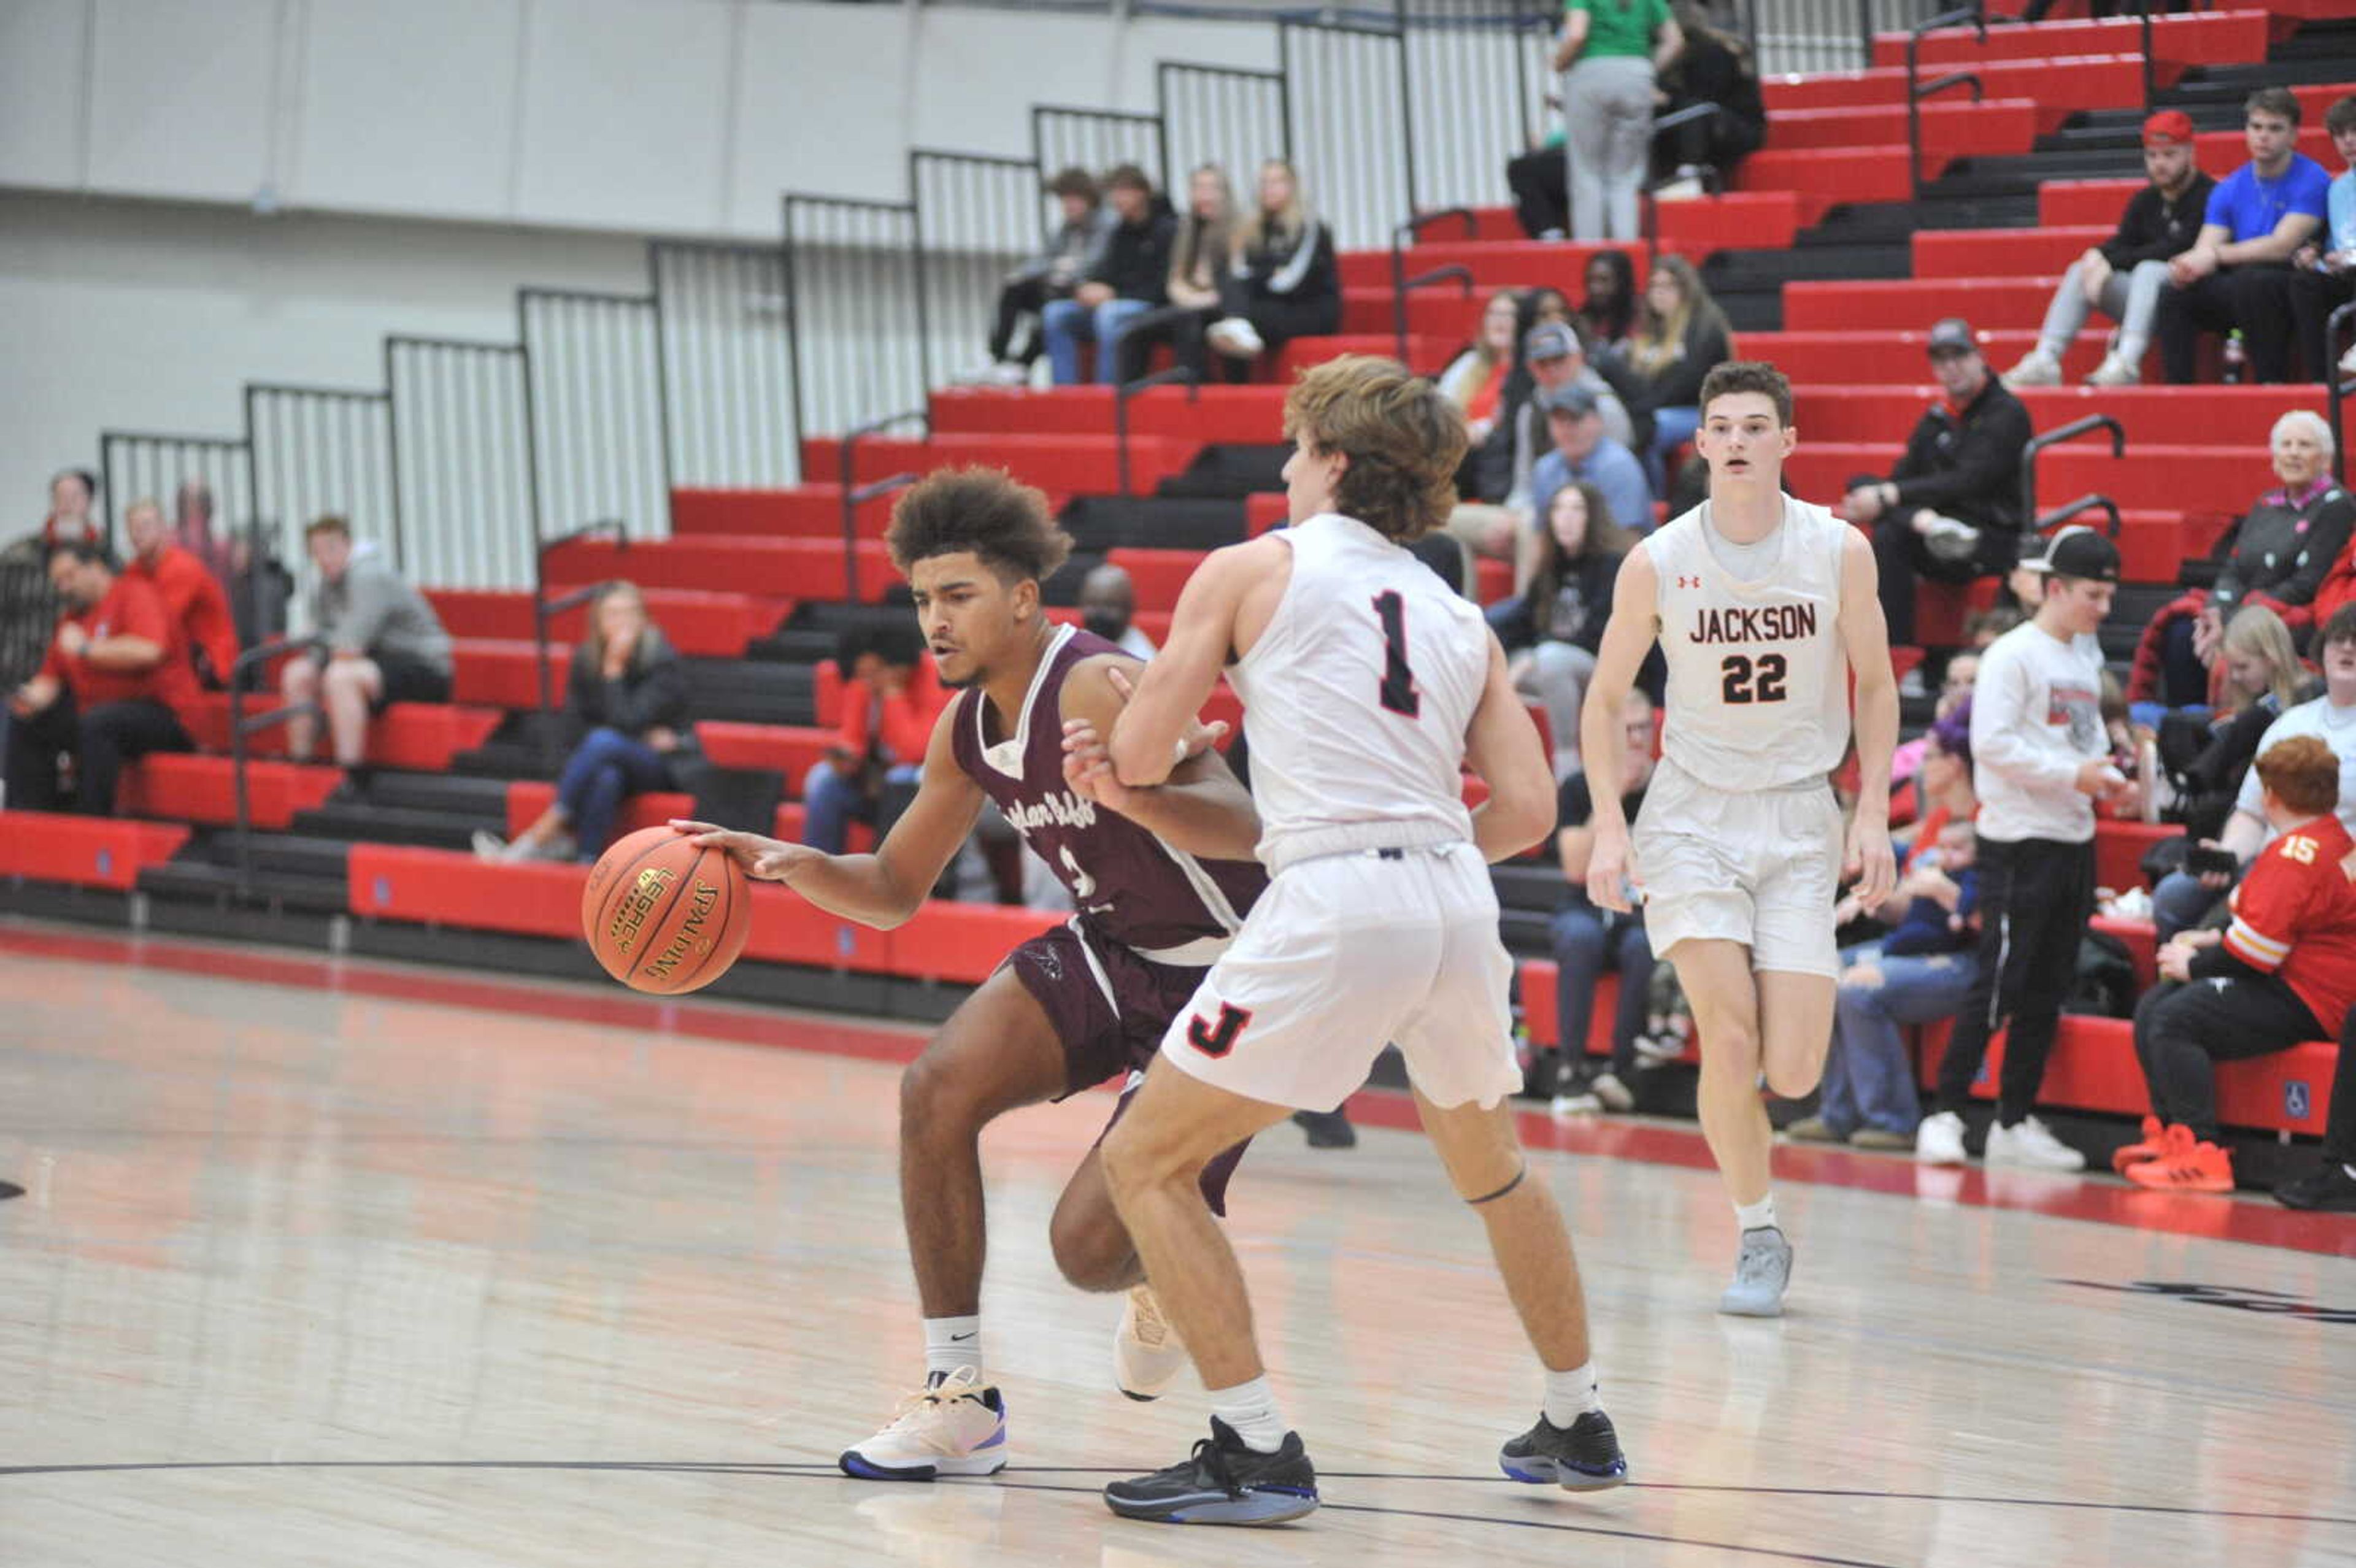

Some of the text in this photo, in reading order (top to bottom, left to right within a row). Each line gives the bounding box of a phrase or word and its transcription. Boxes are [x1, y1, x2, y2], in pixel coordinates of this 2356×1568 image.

[1690, 602, 1817, 644] JACKSON
[1371, 589, 1420, 720] 1
[1721, 653, 1787, 704] 22
[2279, 834, 2320, 866] 15
[618, 868, 676, 954] LEGACY
[645, 879, 718, 981] SPALDING
[1188, 1001, 1253, 1060] J
